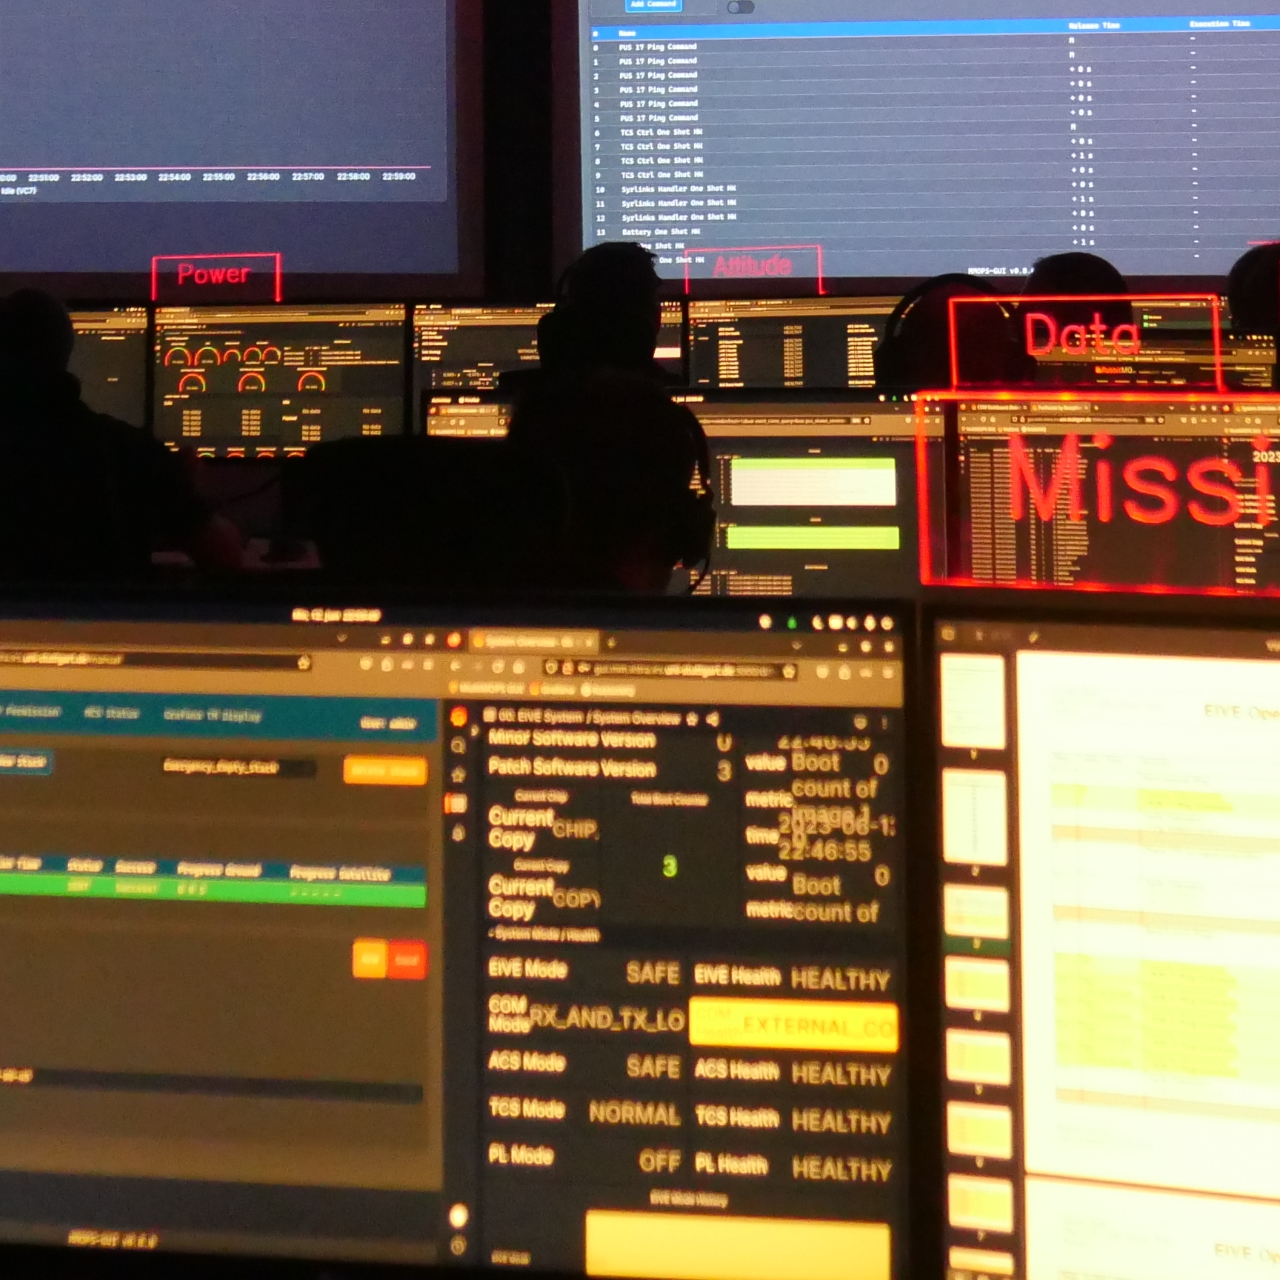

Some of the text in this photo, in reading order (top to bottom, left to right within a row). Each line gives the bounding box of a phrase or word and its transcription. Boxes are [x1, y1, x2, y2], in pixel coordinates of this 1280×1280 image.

[631, 0, 676, 8] Add Command
[619, 42, 697, 52] PUS 17 Ping Command
[637, 128, 654, 136] Ctrl
[658, 128, 670, 136] One
[673, 128, 690, 136] Shot
[115, 173, 147, 181] 22:53:00
[383, 172, 416, 180] 22:59:00
[1, 186, 37, 195] Idle (VC7)
[622, 186, 654, 195] Syrlinks
[658, 185, 687, 193] Handler
[707, 184, 724, 192] Shot
[623, 228, 651, 237] Battery
[671, 227, 688, 235] Shot
[177, 264, 252, 285] Power
[713, 255, 792, 277] Attitude
[1026, 313, 1140, 356] Data
[1204, 704, 1241, 718] EIVE
[489, 731, 656, 748] Minor Software Version
[489, 760, 731, 781] Patch Software Version 3
[746, 752, 889, 774] value Boot 0
[792, 779, 878, 798] count of
[746, 792, 794, 808] metric
[489, 807, 554, 827] Current
[489, 829, 535, 851] Copy
[746, 827, 780, 844] time
[779, 841, 872, 861] 22:46:55
[662, 855, 677, 877] 3
[746, 865, 890, 886] value 0
[489, 876, 554, 896] Current
[793, 876, 840, 896] Boot
[489, 899, 535, 921] Copy
[746, 902, 878, 924] metric count of
[489, 958, 680, 984] EIVE Mode SAFE
[695, 964, 890, 991] EIVE Health HEALTHY
[489, 995, 527, 1014] COM
[489, 1017, 530, 1033] Mode
[489, 1052, 680, 1079] ACS Mode SAFE
[695, 1059, 891, 1086] ACS Health HEALTHY
[489, 1097, 681, 1126] TCS Mode NORMAL
[696, 1105, 891, 1134] TCS Health HEALTHY
[489, 1143, 681, 1173] PL Mode OFF
[696, 1151, 892, 1182] PL Health HEALTHY
[1214, 1243, 1251, 1259] EIVE
